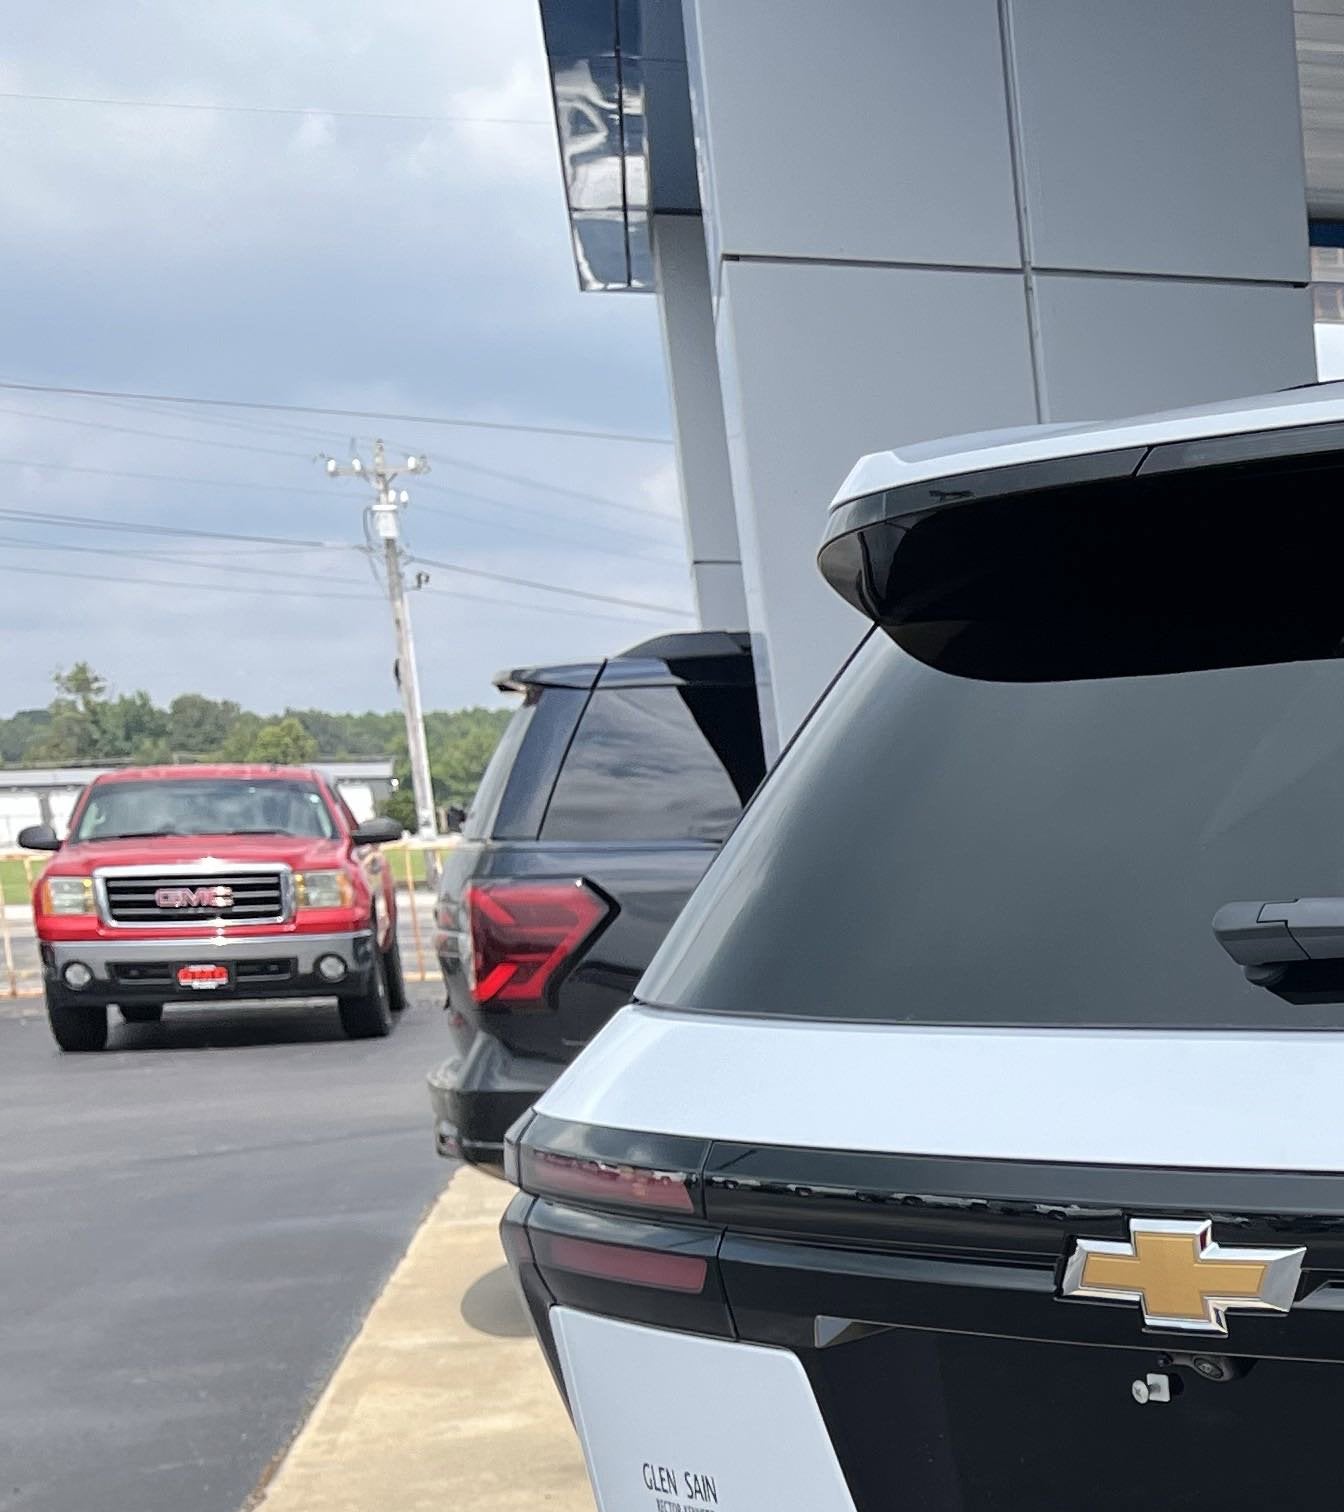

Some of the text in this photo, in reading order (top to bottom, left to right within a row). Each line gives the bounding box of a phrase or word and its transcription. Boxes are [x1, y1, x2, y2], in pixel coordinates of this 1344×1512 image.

[154, 886, 234, 908] GMC
[642, 1462, 718, 1504] GLEN SAIN
